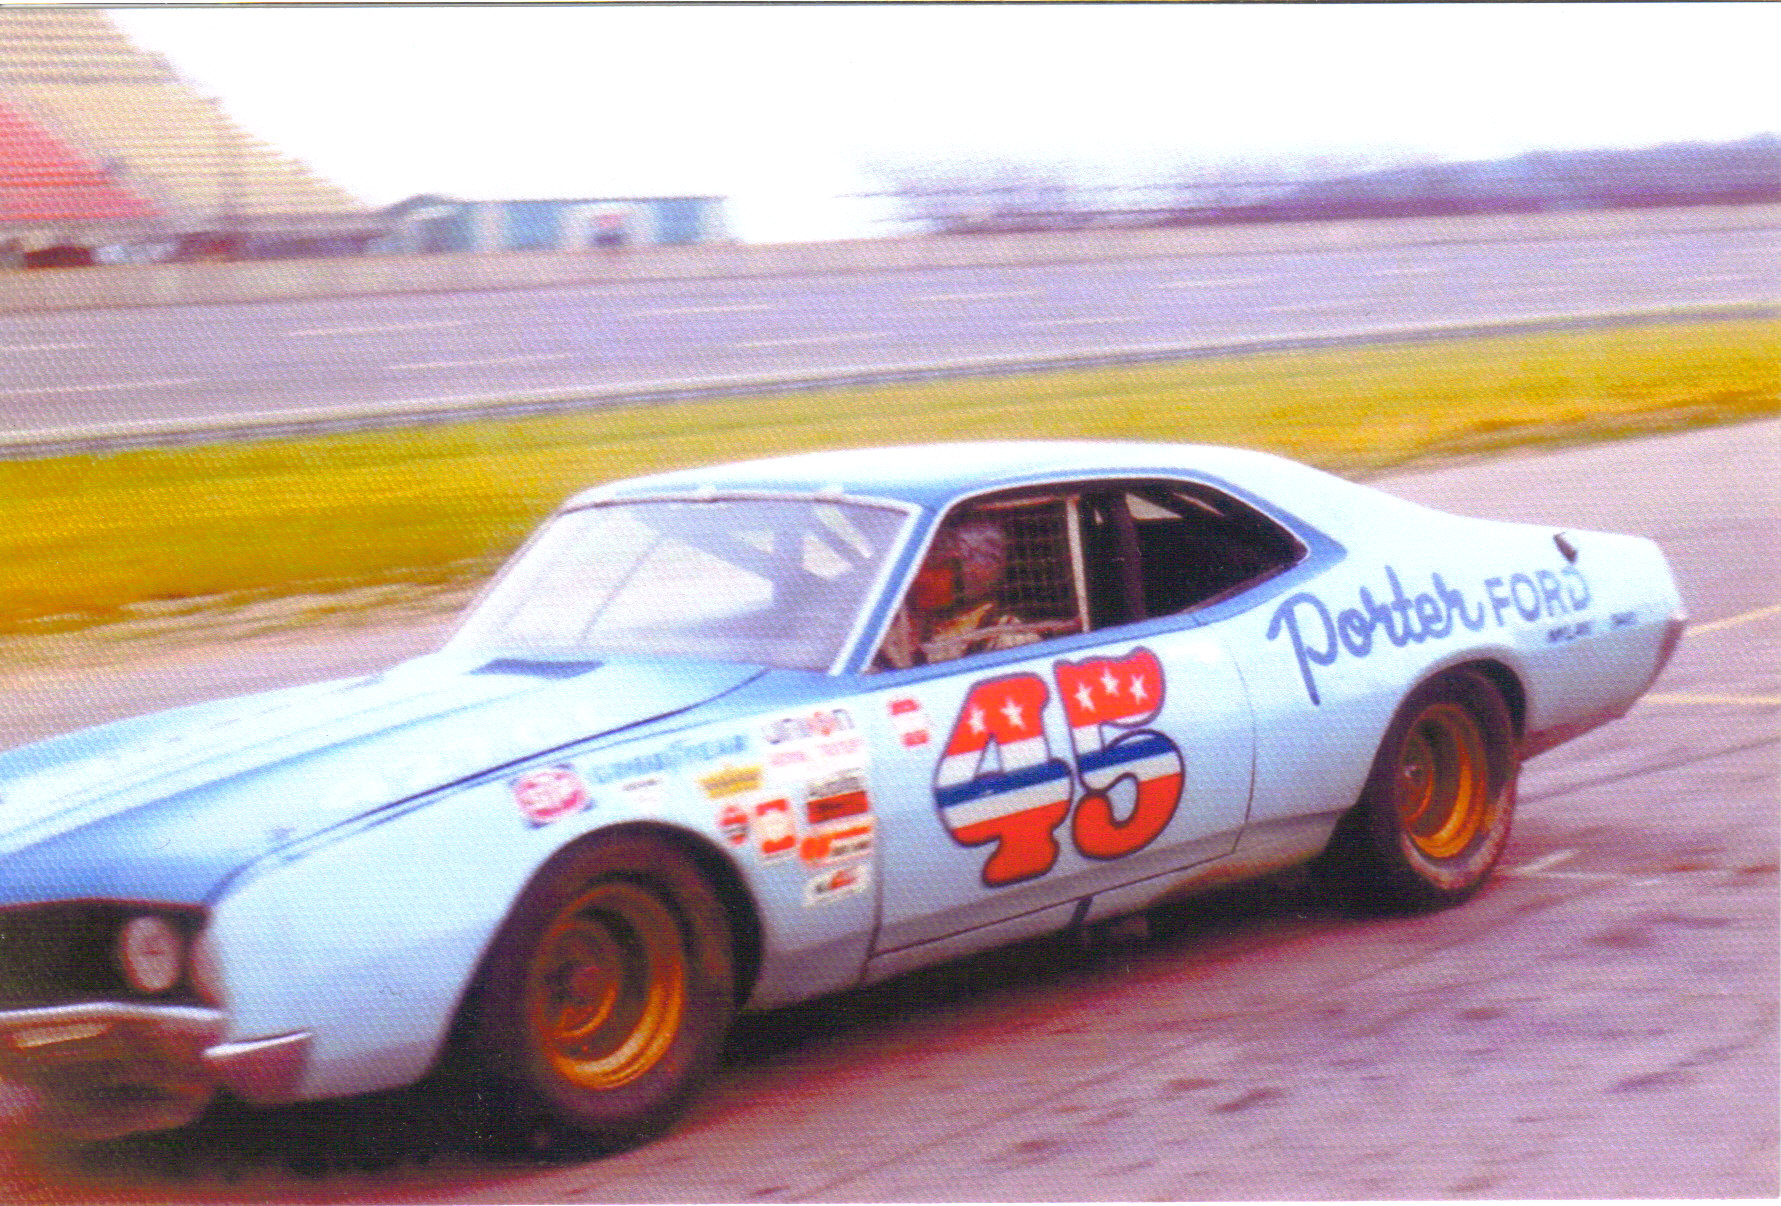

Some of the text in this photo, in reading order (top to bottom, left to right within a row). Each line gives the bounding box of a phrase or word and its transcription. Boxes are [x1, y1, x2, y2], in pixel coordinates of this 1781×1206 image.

[1266, 565, 1592, 706] Porter FORD
[932, 646, 1187, 889] 45
